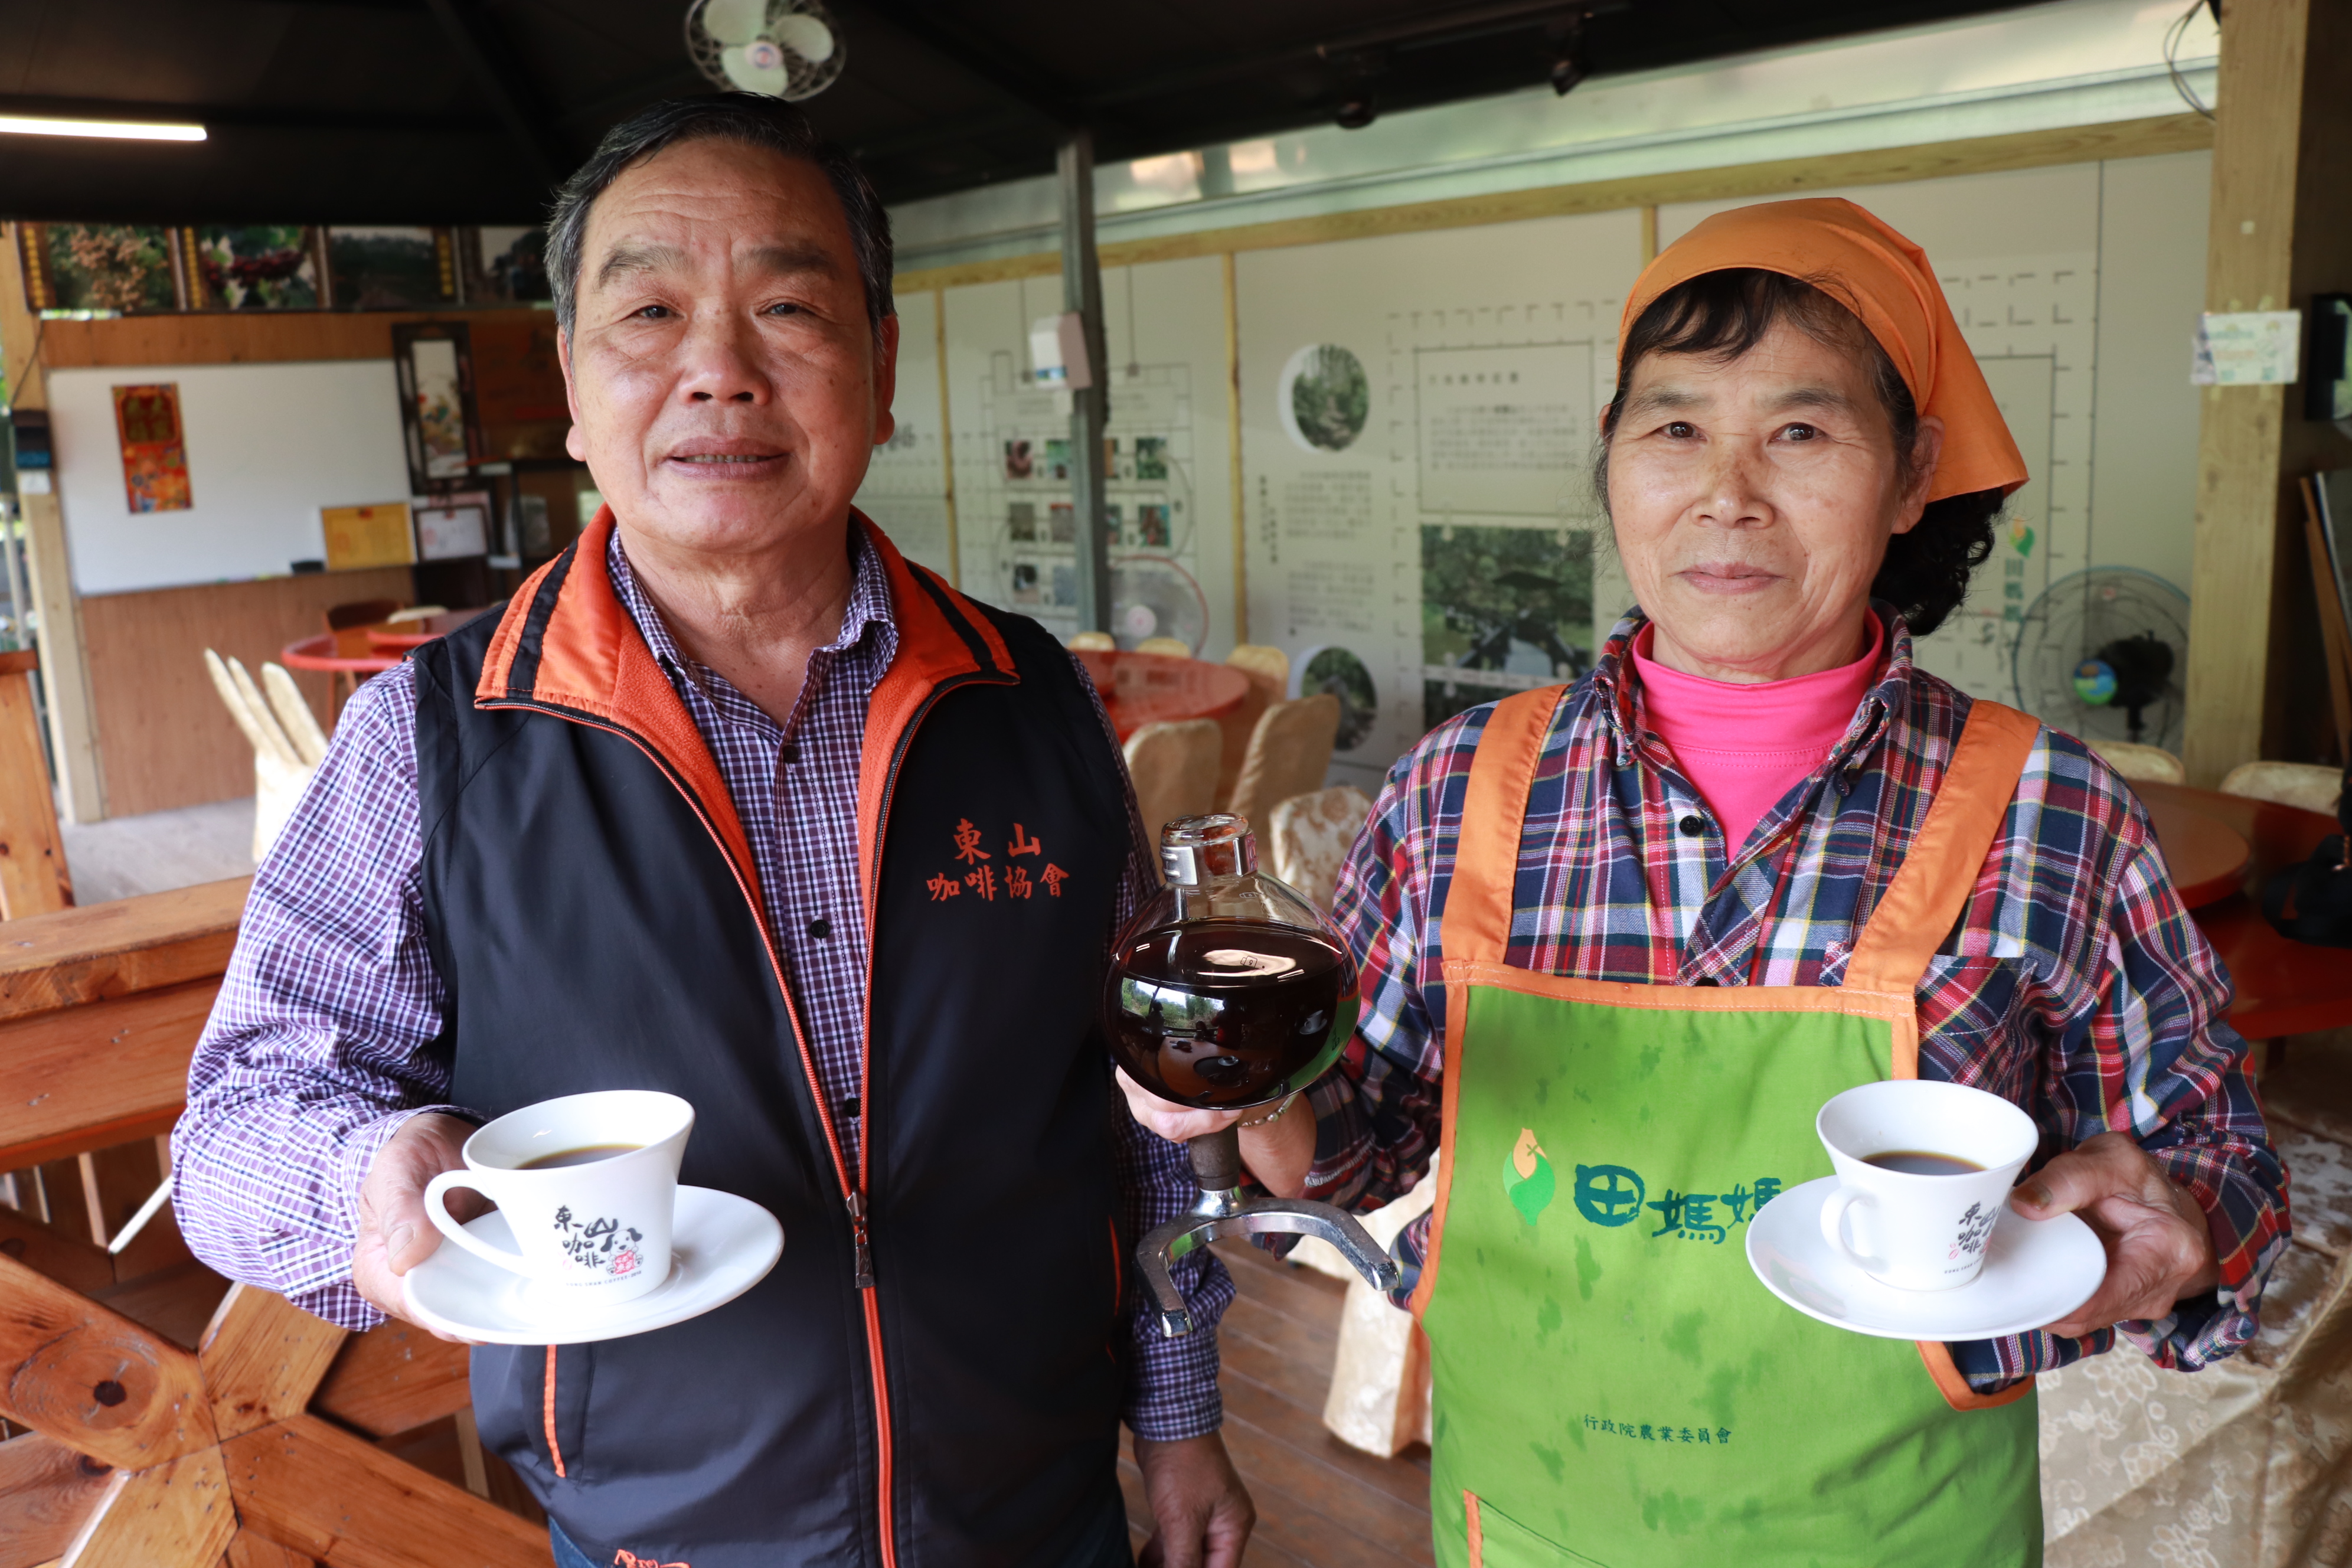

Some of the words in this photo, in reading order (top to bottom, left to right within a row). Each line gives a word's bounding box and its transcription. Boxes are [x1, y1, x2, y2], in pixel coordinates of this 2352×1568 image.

[953, 818, 1041, 865] 東山
[926, 862, 1070, 901] 咖啡協會
[553, 1204, 619, 1239] 東山
[562, 1232, 606, 1269] 咖啡
[1584, 1413, 1732, 1445] 行政院農業委員會
